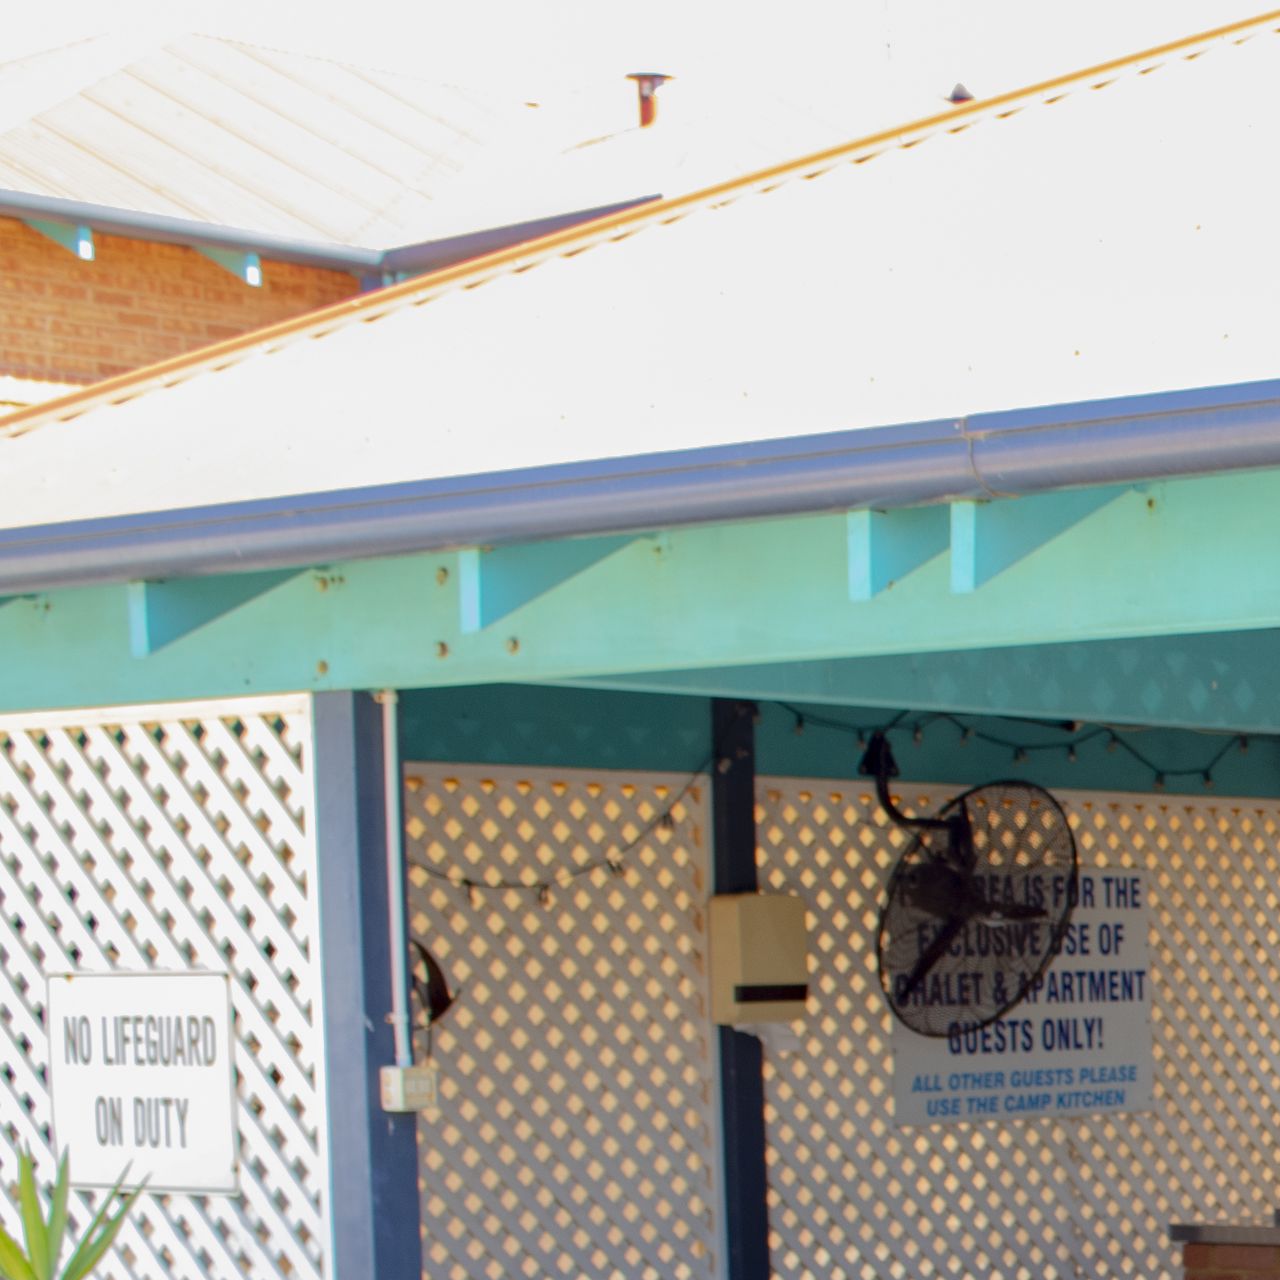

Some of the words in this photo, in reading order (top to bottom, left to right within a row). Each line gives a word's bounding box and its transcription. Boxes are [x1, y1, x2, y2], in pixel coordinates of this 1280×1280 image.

[1103, 876, 1142, 909] THE
[1098, 923, 1124, 955] OF
[993, 975, 1008, 1006] &
[1018, 970, 1146, 1006] APARTMENT
[63, 1015, 92, 1066] NO
[101, 1015, 217, 1067] LIFEGUARD
[948, 1020, 1034, 1055] GUESTS
[1042, 1017, 1104, 1051] ONLY!
[911, 1075, 942, 1093] ALL
[947, 1071, 1005, 1091] OTHER
[1010, 1068, 1074, 1089] GUESTS
[1079, 1064, 1138, 1084] PLEASE
[927, 1098, 961, 1117] USE
[966, 1096, 1000, 1114] THE
[1004, 1093, 1052, 1113] CAMP
[1056, 1089, 1126, 1110] KITCHEN
[95, 1096, 123, 1147] ON
[133, 1097, 189, 1149] DUTY
